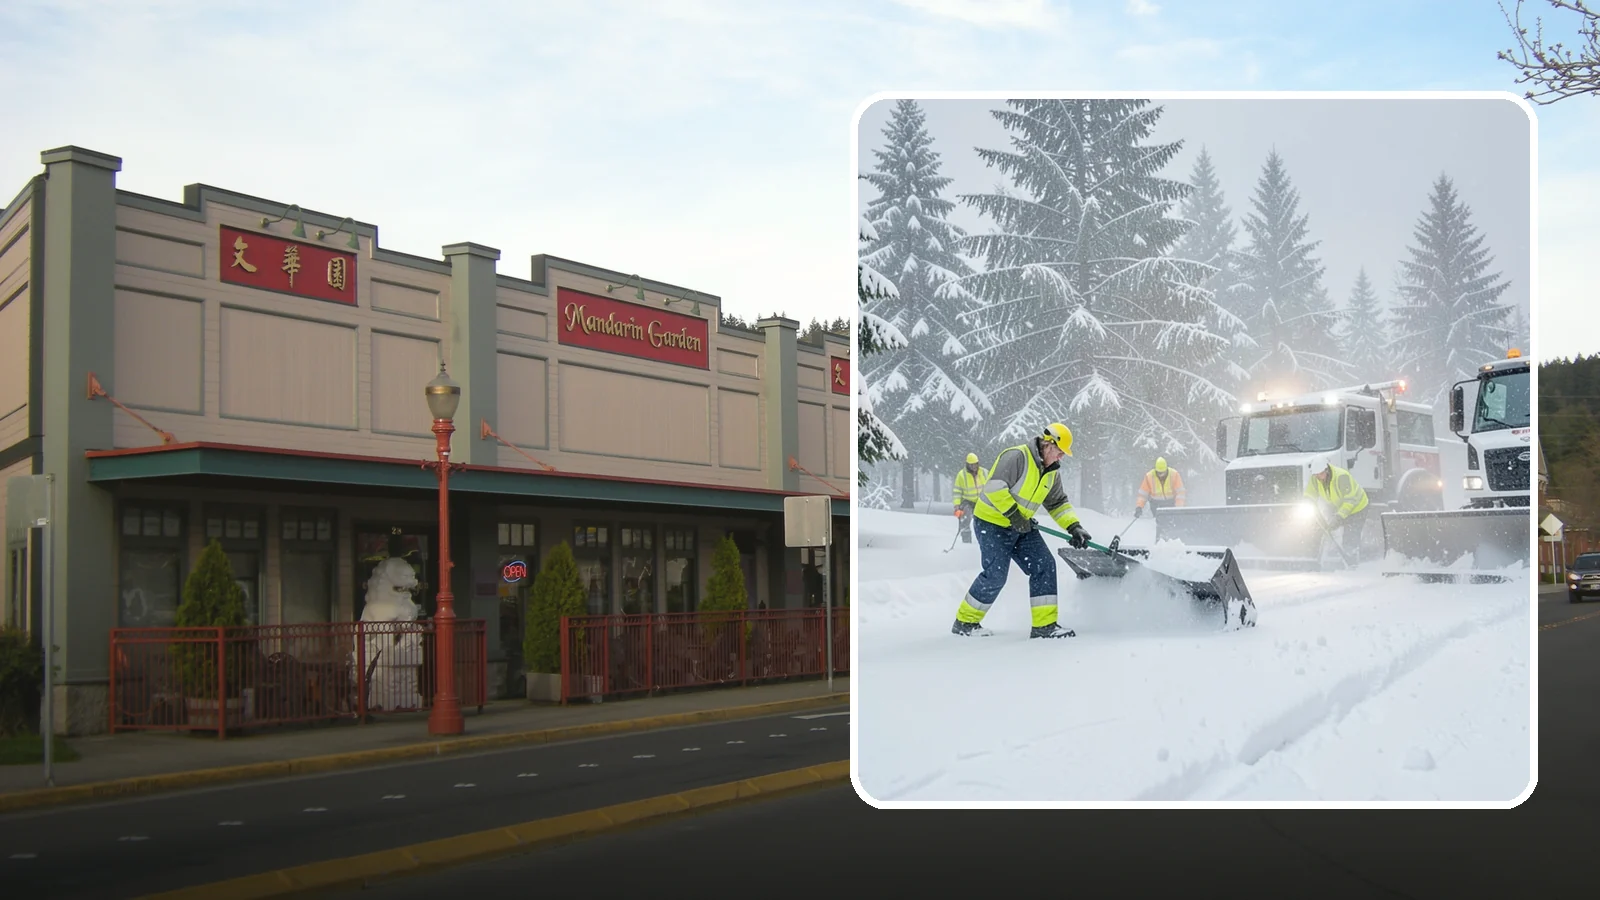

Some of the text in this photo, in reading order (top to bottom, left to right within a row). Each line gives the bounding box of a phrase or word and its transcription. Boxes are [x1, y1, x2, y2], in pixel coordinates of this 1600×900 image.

[231, 235, 346, 291] 文華園
[564, 302, 701, 352] Mandarin Garden
[503, 565, 527, 578] OPEN
